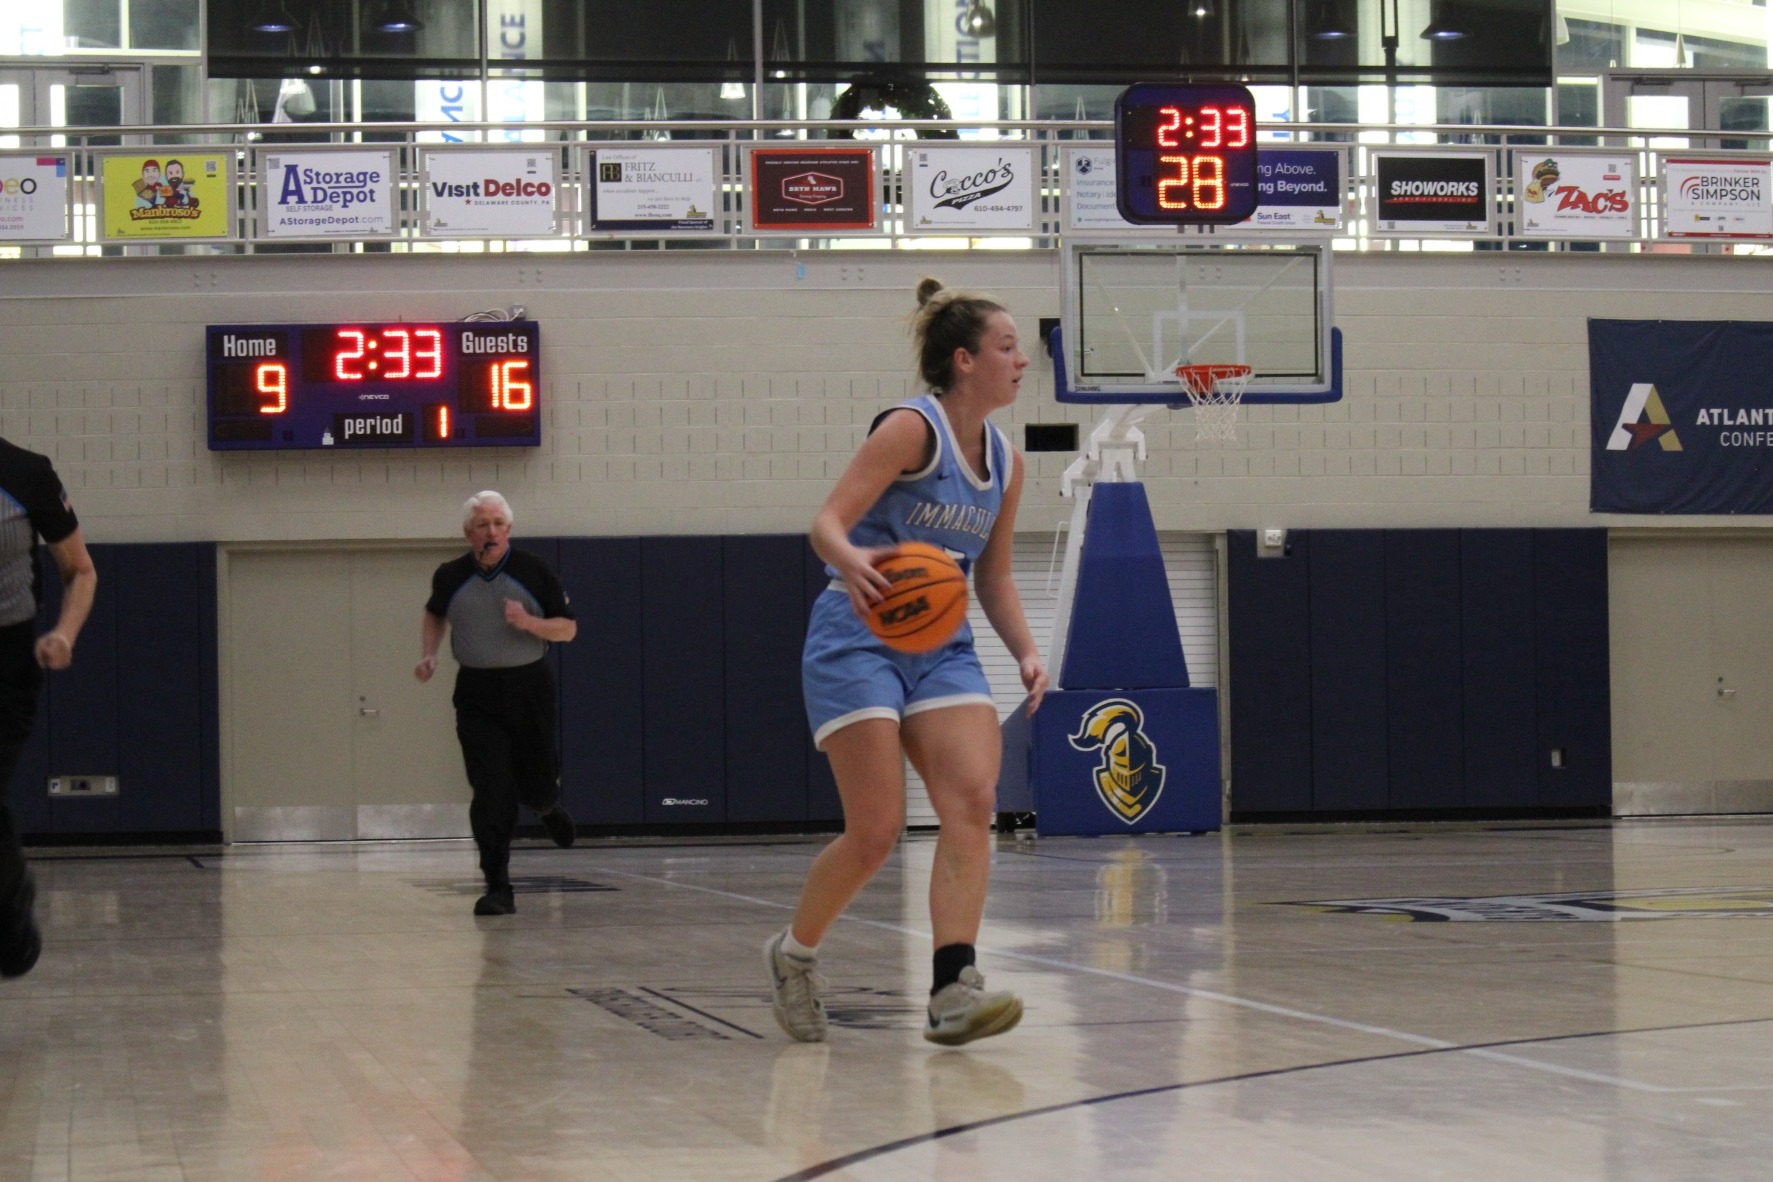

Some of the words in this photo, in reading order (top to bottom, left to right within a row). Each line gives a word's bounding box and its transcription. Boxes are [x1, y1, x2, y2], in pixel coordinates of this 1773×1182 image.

[1157, 107, 1248, 148] 2:33
[624, 162, 656, 172] FRITZ
[624, 173, 633, 182] &
[636, 172, 693, 182] BIANCULLI
[1274, 162, 1316, 174] Above.
[278, 164, 308, 205] A
[303, 168, 381, 190] Storage
[484, 177, 551, 197] Delco
[1158, 155, 1225, 209] 28
[1277, 180, 1328, 194] Beyond.
[1391, 180, 1479, 196] SHOWORKS
[1700, 176, 1760, 188] BRINKER
[310, 186, 376, 208] Depot
[1691, 188, 1761, 201] SIMPSON
[131, 204, 199, 218] Manbroso's
[303, 204, 333, 212] STORAGE
[223, 335, 277, 357] Home
[461, 331, 528, 354] Guests
[335, 330, 442, 380] 2:33
[256, 364, 286, 414] 9
[489, 361, 531, 410] 16
[344, 414, 403, 439] period
[438, 406, 448, 439] 1
[1696, 408, 1773, 426] ATLANT
[904, 501, 997, 541] IMMACUL
